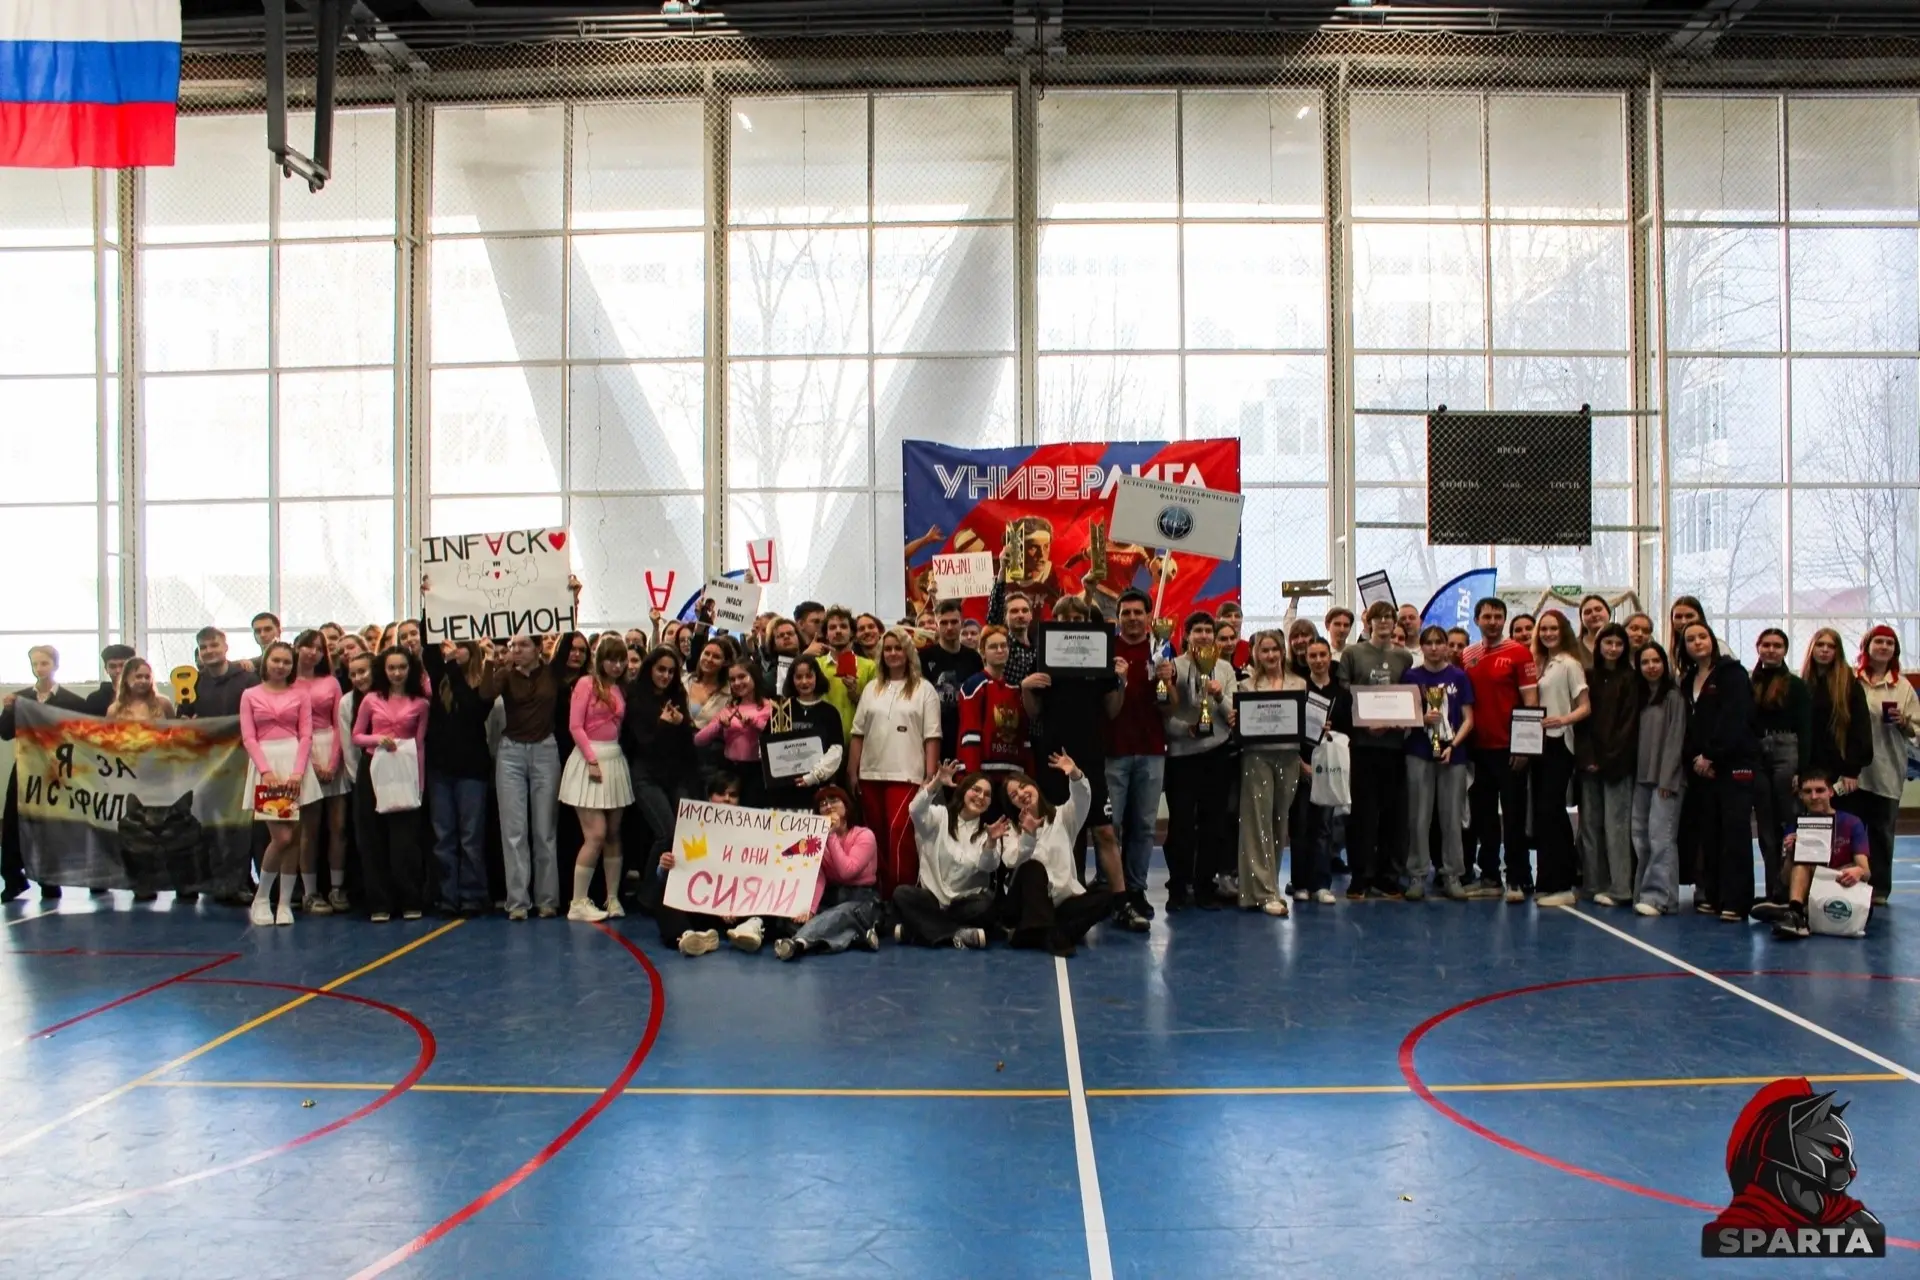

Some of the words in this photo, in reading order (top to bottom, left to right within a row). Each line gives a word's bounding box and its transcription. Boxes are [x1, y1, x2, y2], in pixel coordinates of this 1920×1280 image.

[1159, 493, 1201, 506] ФАКУЛЬТЕТ
[427, 606, 575, 641] ЧЕМПИОН
[717, 608, 745, 623] SUPREMACY
[56, 744, 74, 778] Я
[96, 754, 137, 779] ЗА
[780, 815, 830, 834] СИЯТЬ
[722, 844, 734, 864] И
[741, 847, 769, 866] ОНИ
[687, 870, 801, 914] СИЯЛИ
